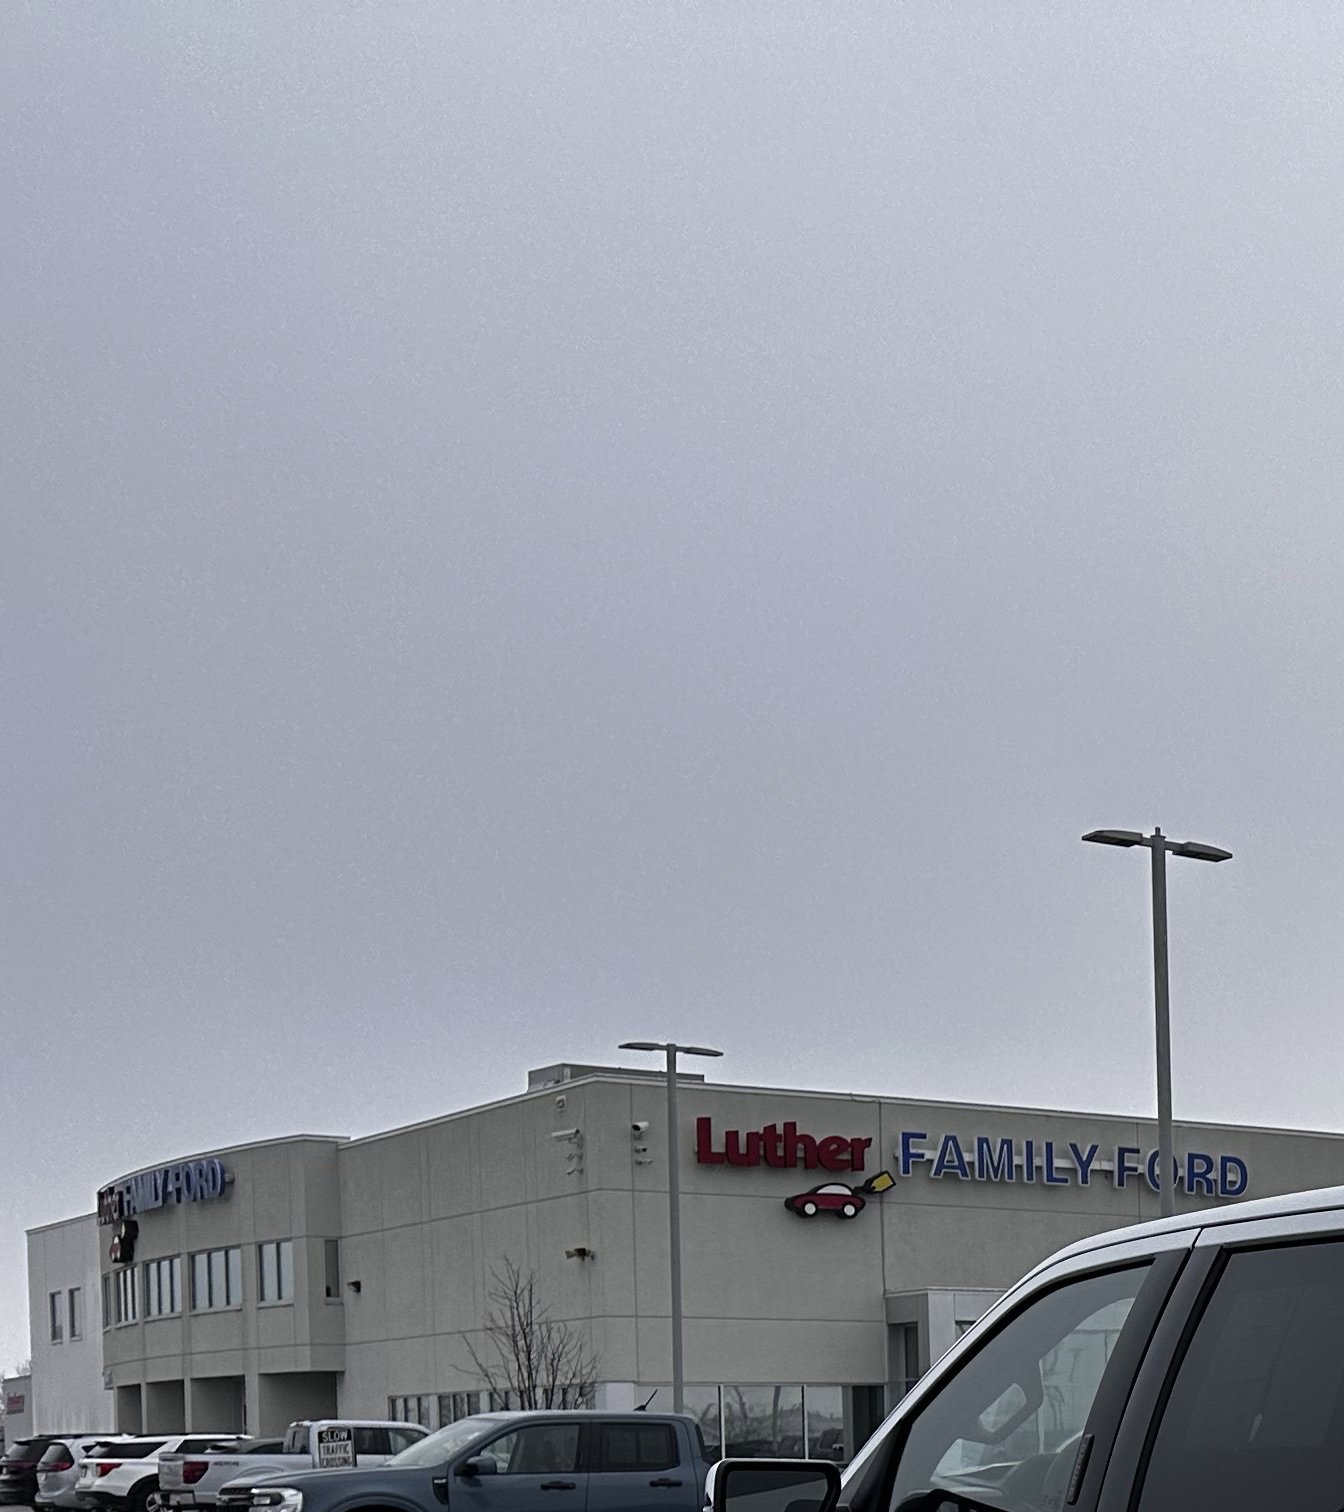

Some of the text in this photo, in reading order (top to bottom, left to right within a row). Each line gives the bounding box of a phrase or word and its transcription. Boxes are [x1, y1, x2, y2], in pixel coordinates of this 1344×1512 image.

[697, 1117, 873, 1172] Luther
[901, 1131, 1249, 1198] FAMILY FORD
[321, 1430, 348, 1442] SLOW
